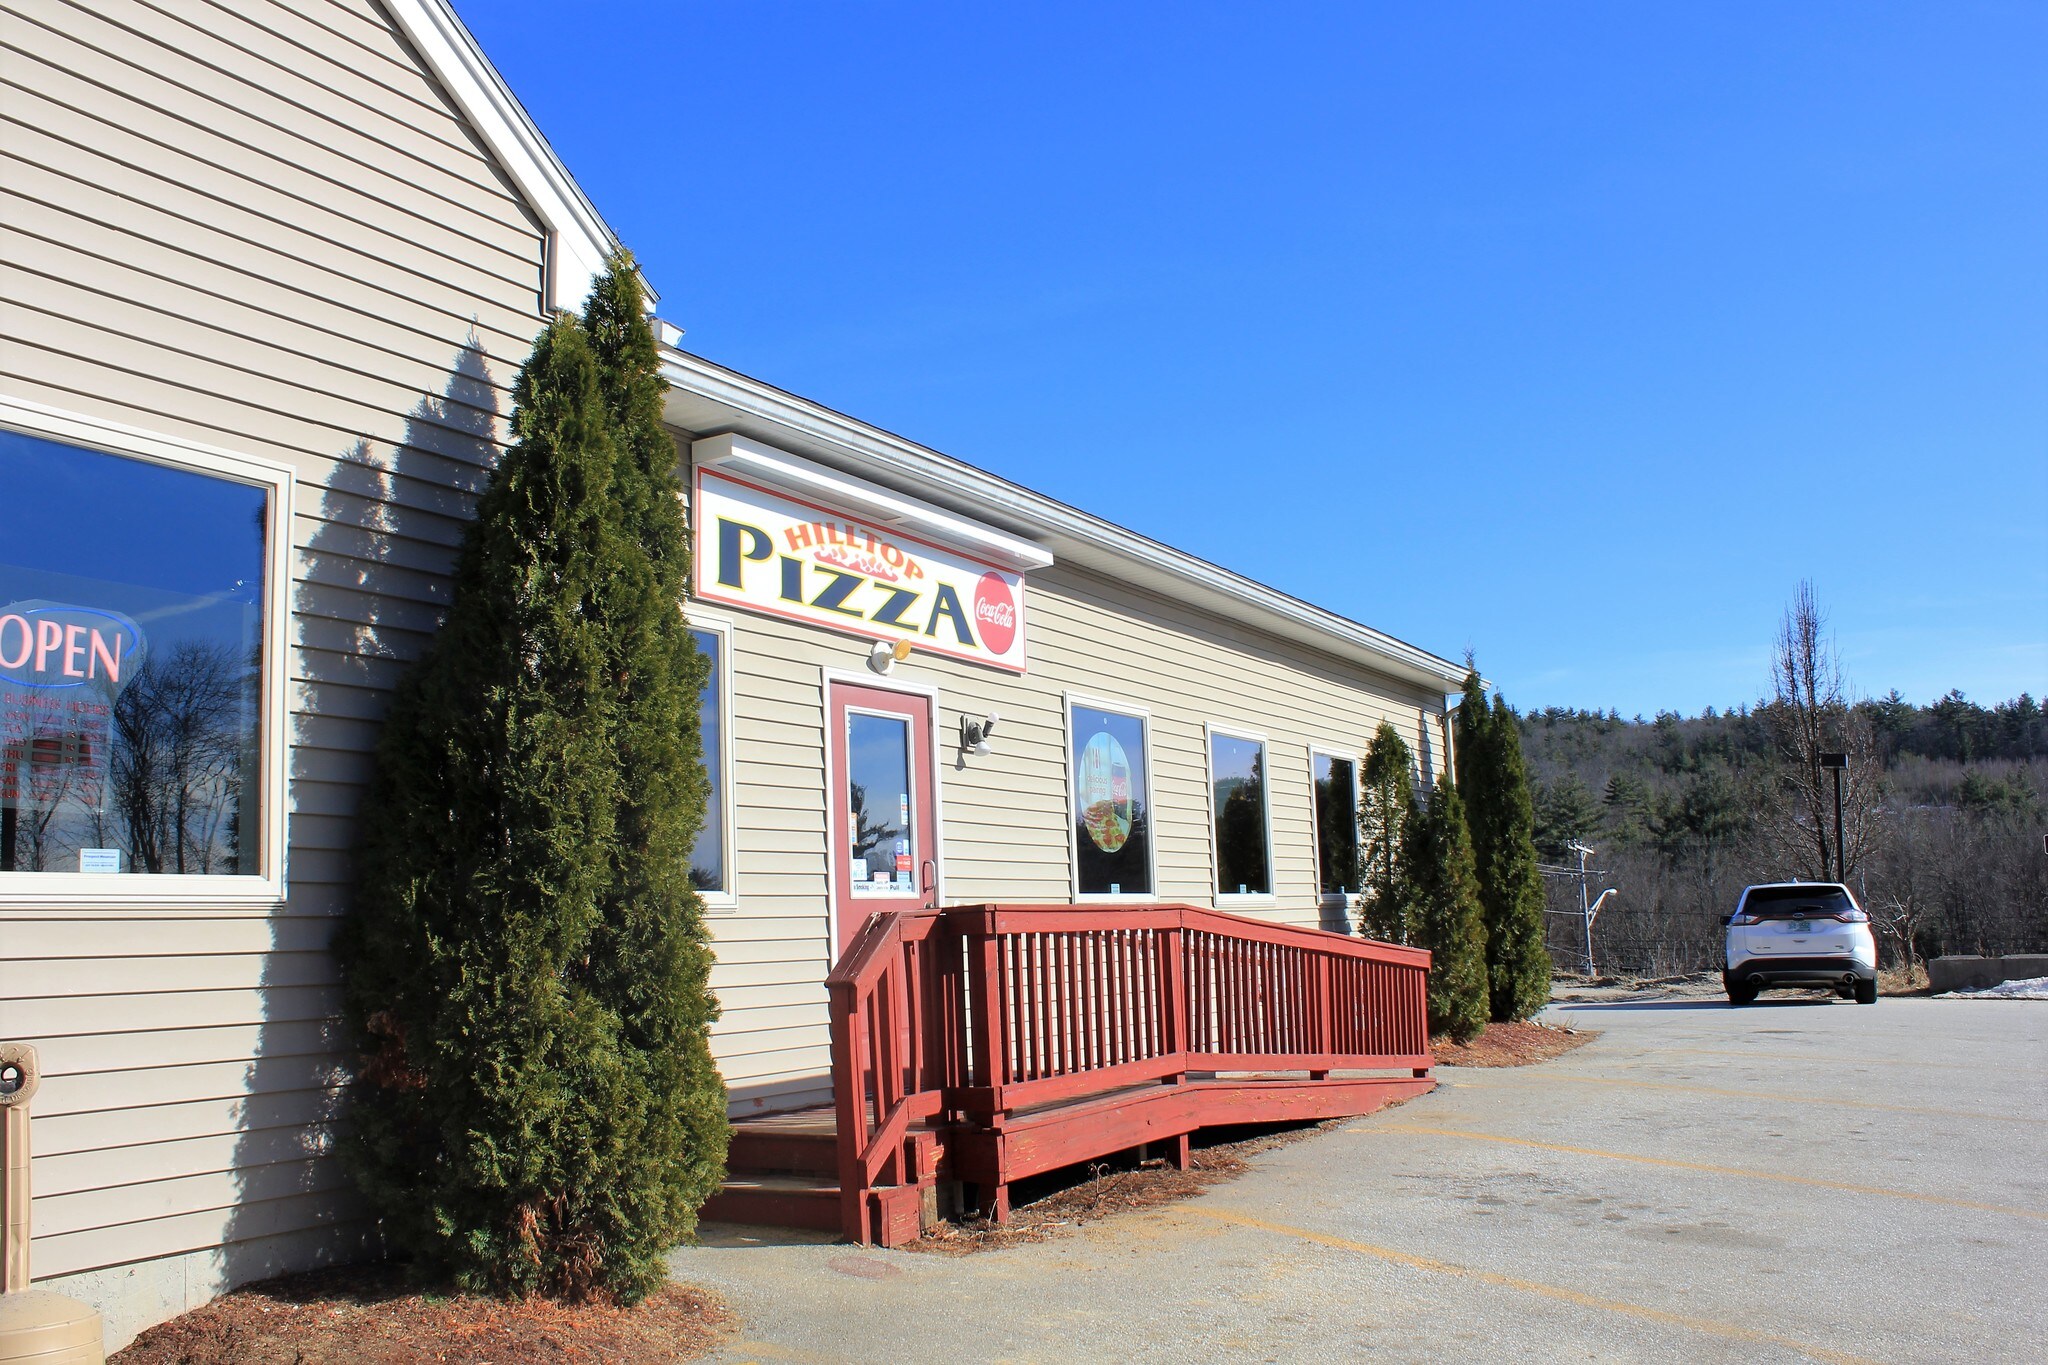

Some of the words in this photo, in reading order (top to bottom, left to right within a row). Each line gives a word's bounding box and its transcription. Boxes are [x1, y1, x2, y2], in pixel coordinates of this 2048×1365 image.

[715, 515, 980, 650] PIZZA
[784, 521, 924, 581] HILLTOP
[976, 596, 1015, 629] Coca-Cola
[0, 614, 121, 683] OPEN
